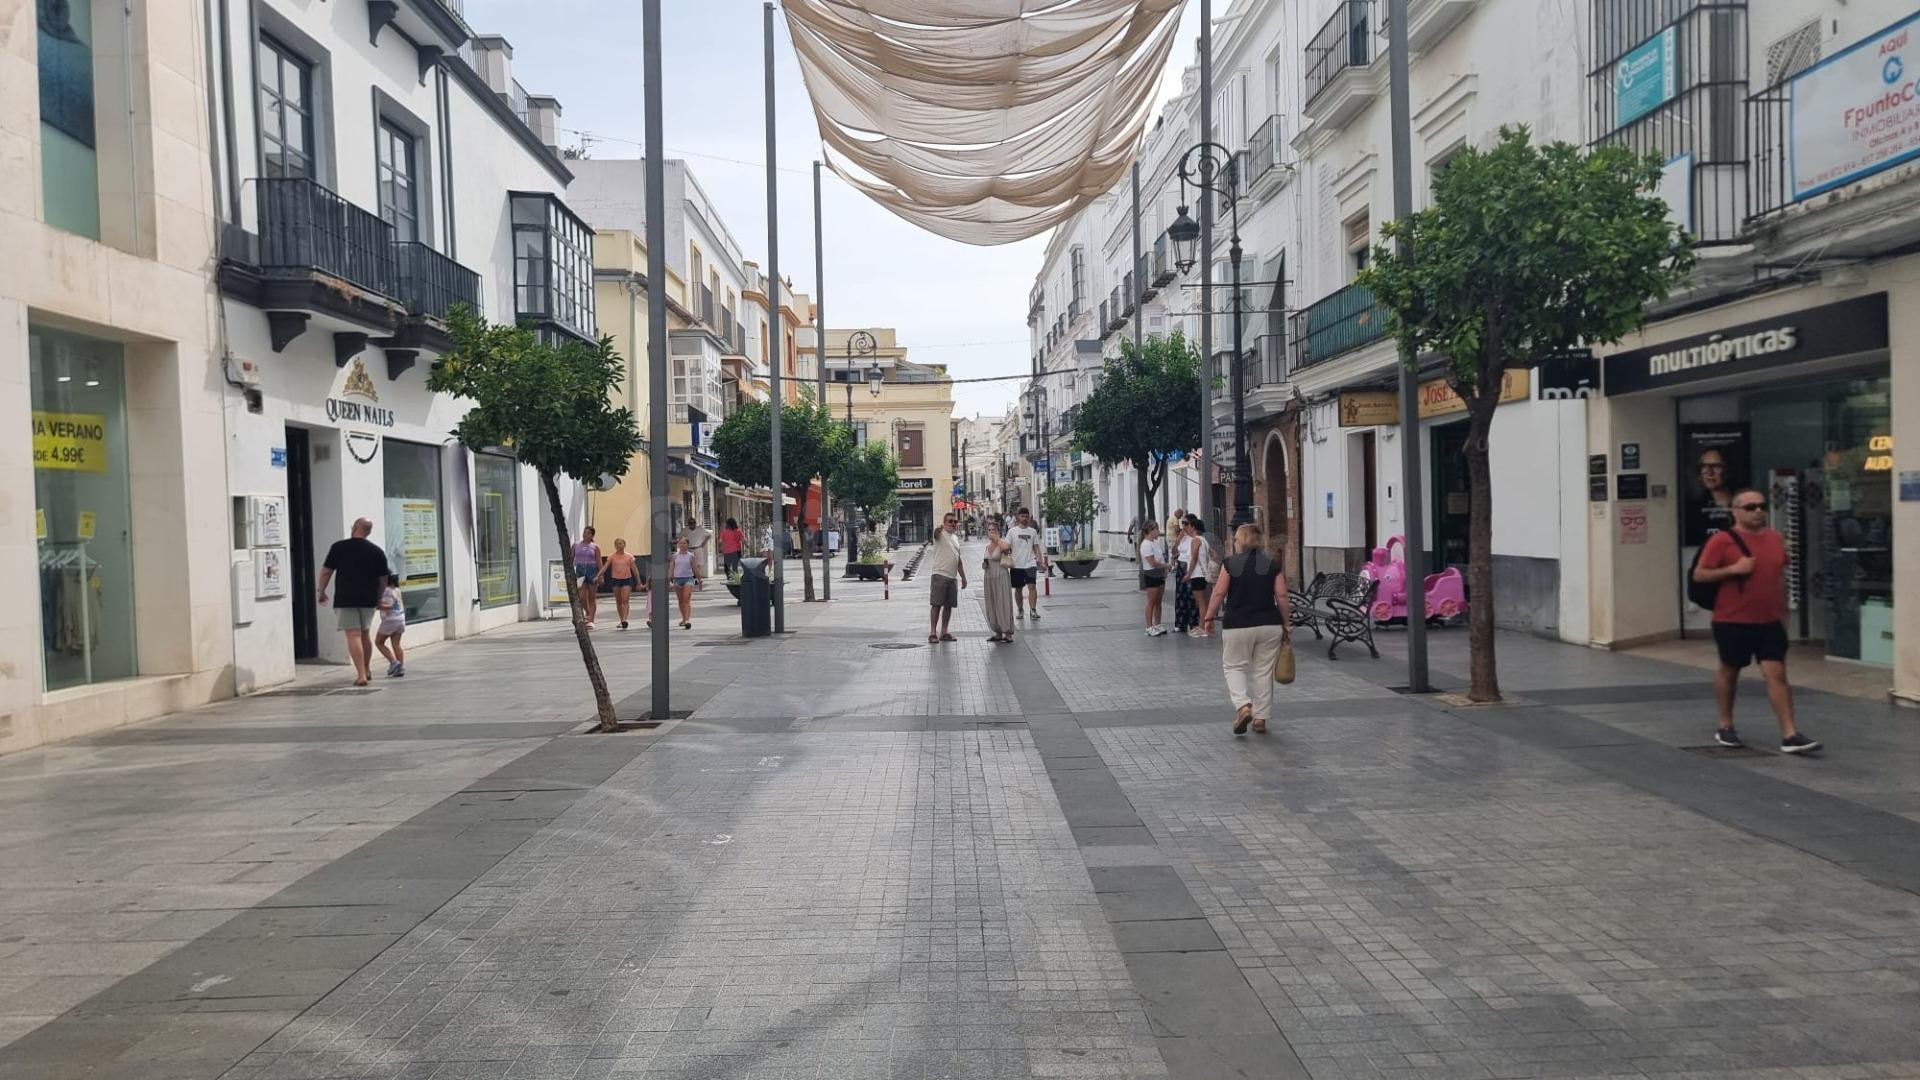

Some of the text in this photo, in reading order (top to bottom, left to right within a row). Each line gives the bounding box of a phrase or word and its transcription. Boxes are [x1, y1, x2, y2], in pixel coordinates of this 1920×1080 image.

[1879, 31, 1909, 58] AQUÍ
[326, 398, 394, 428] QUEEN NAILS
[48, 420, 104, 441] VERANO
[51, 446, 85, 463] 4.99€
